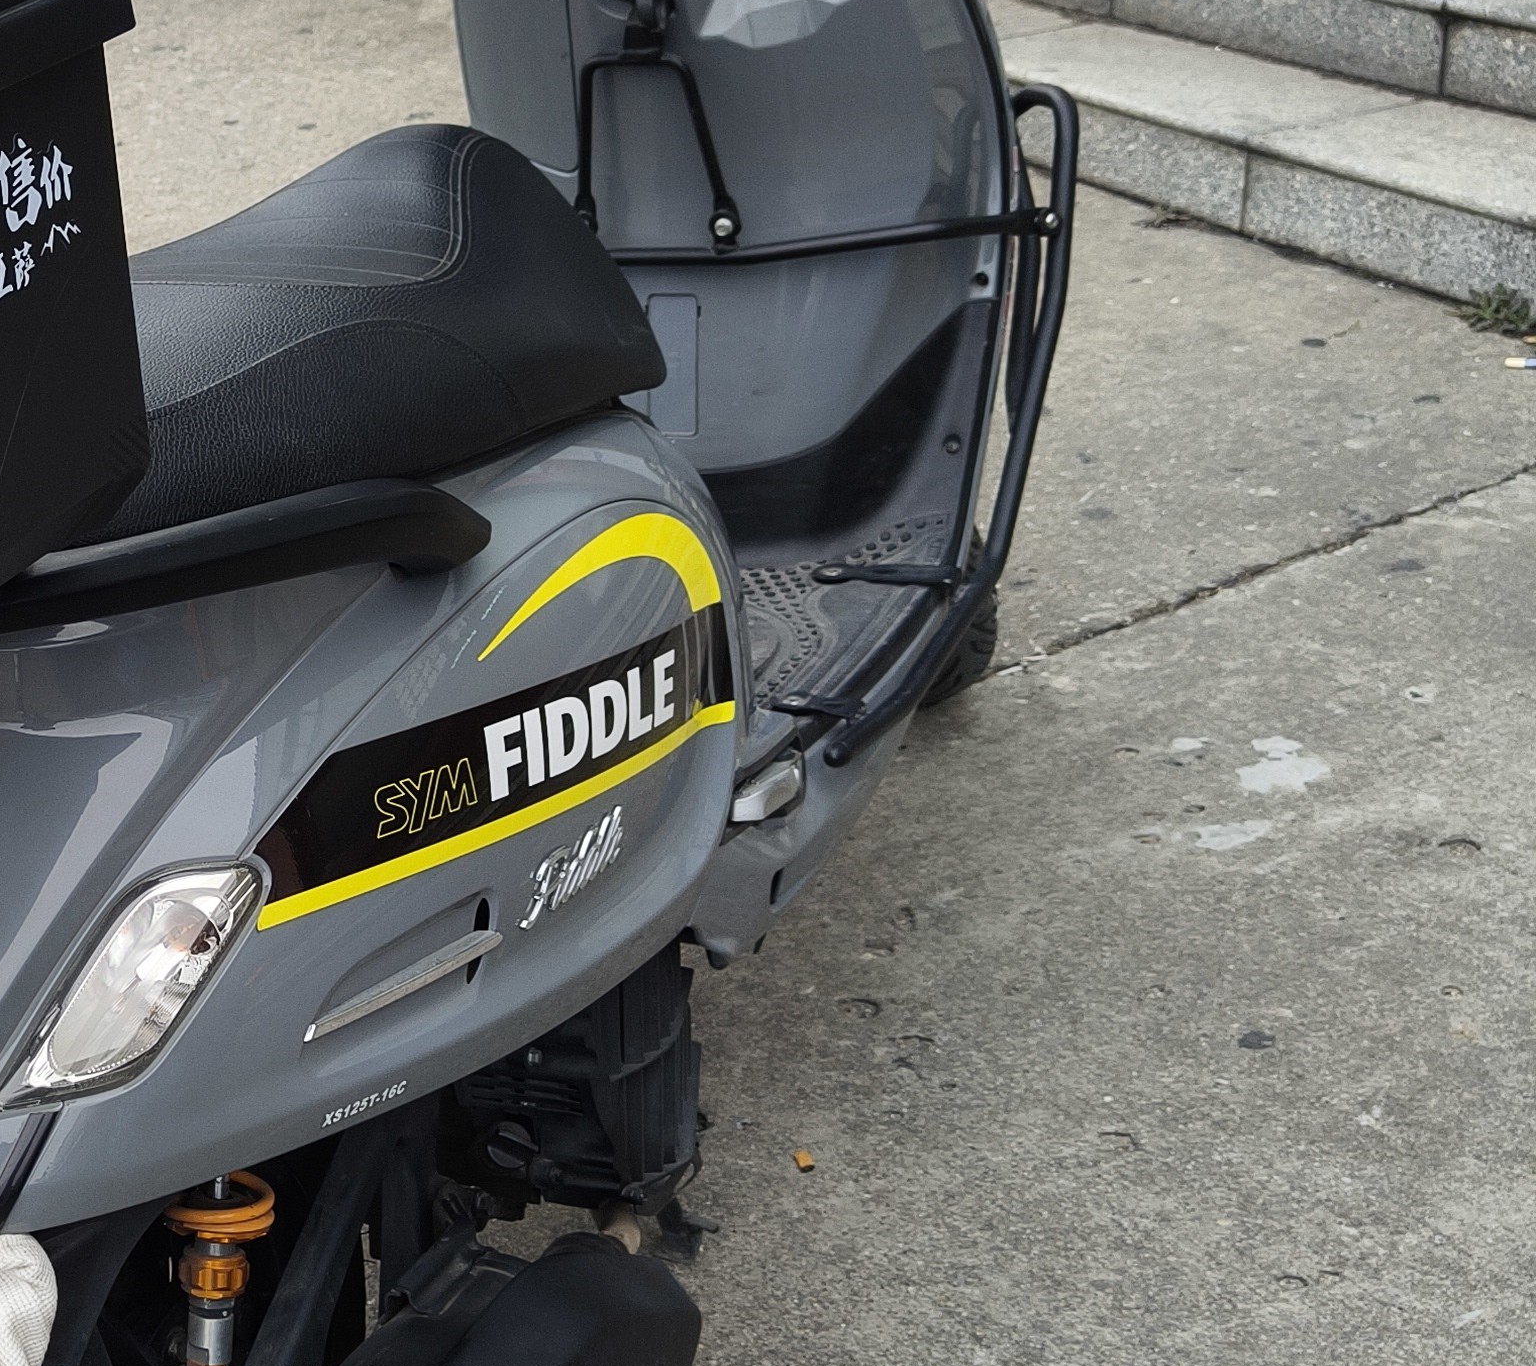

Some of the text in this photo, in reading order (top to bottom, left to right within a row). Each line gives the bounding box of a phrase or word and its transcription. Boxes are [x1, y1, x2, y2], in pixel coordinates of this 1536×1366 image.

[375, 650, 675, 839] SYM FIDDLE
[322, 1080, 407, 1128] XS125T-16C
